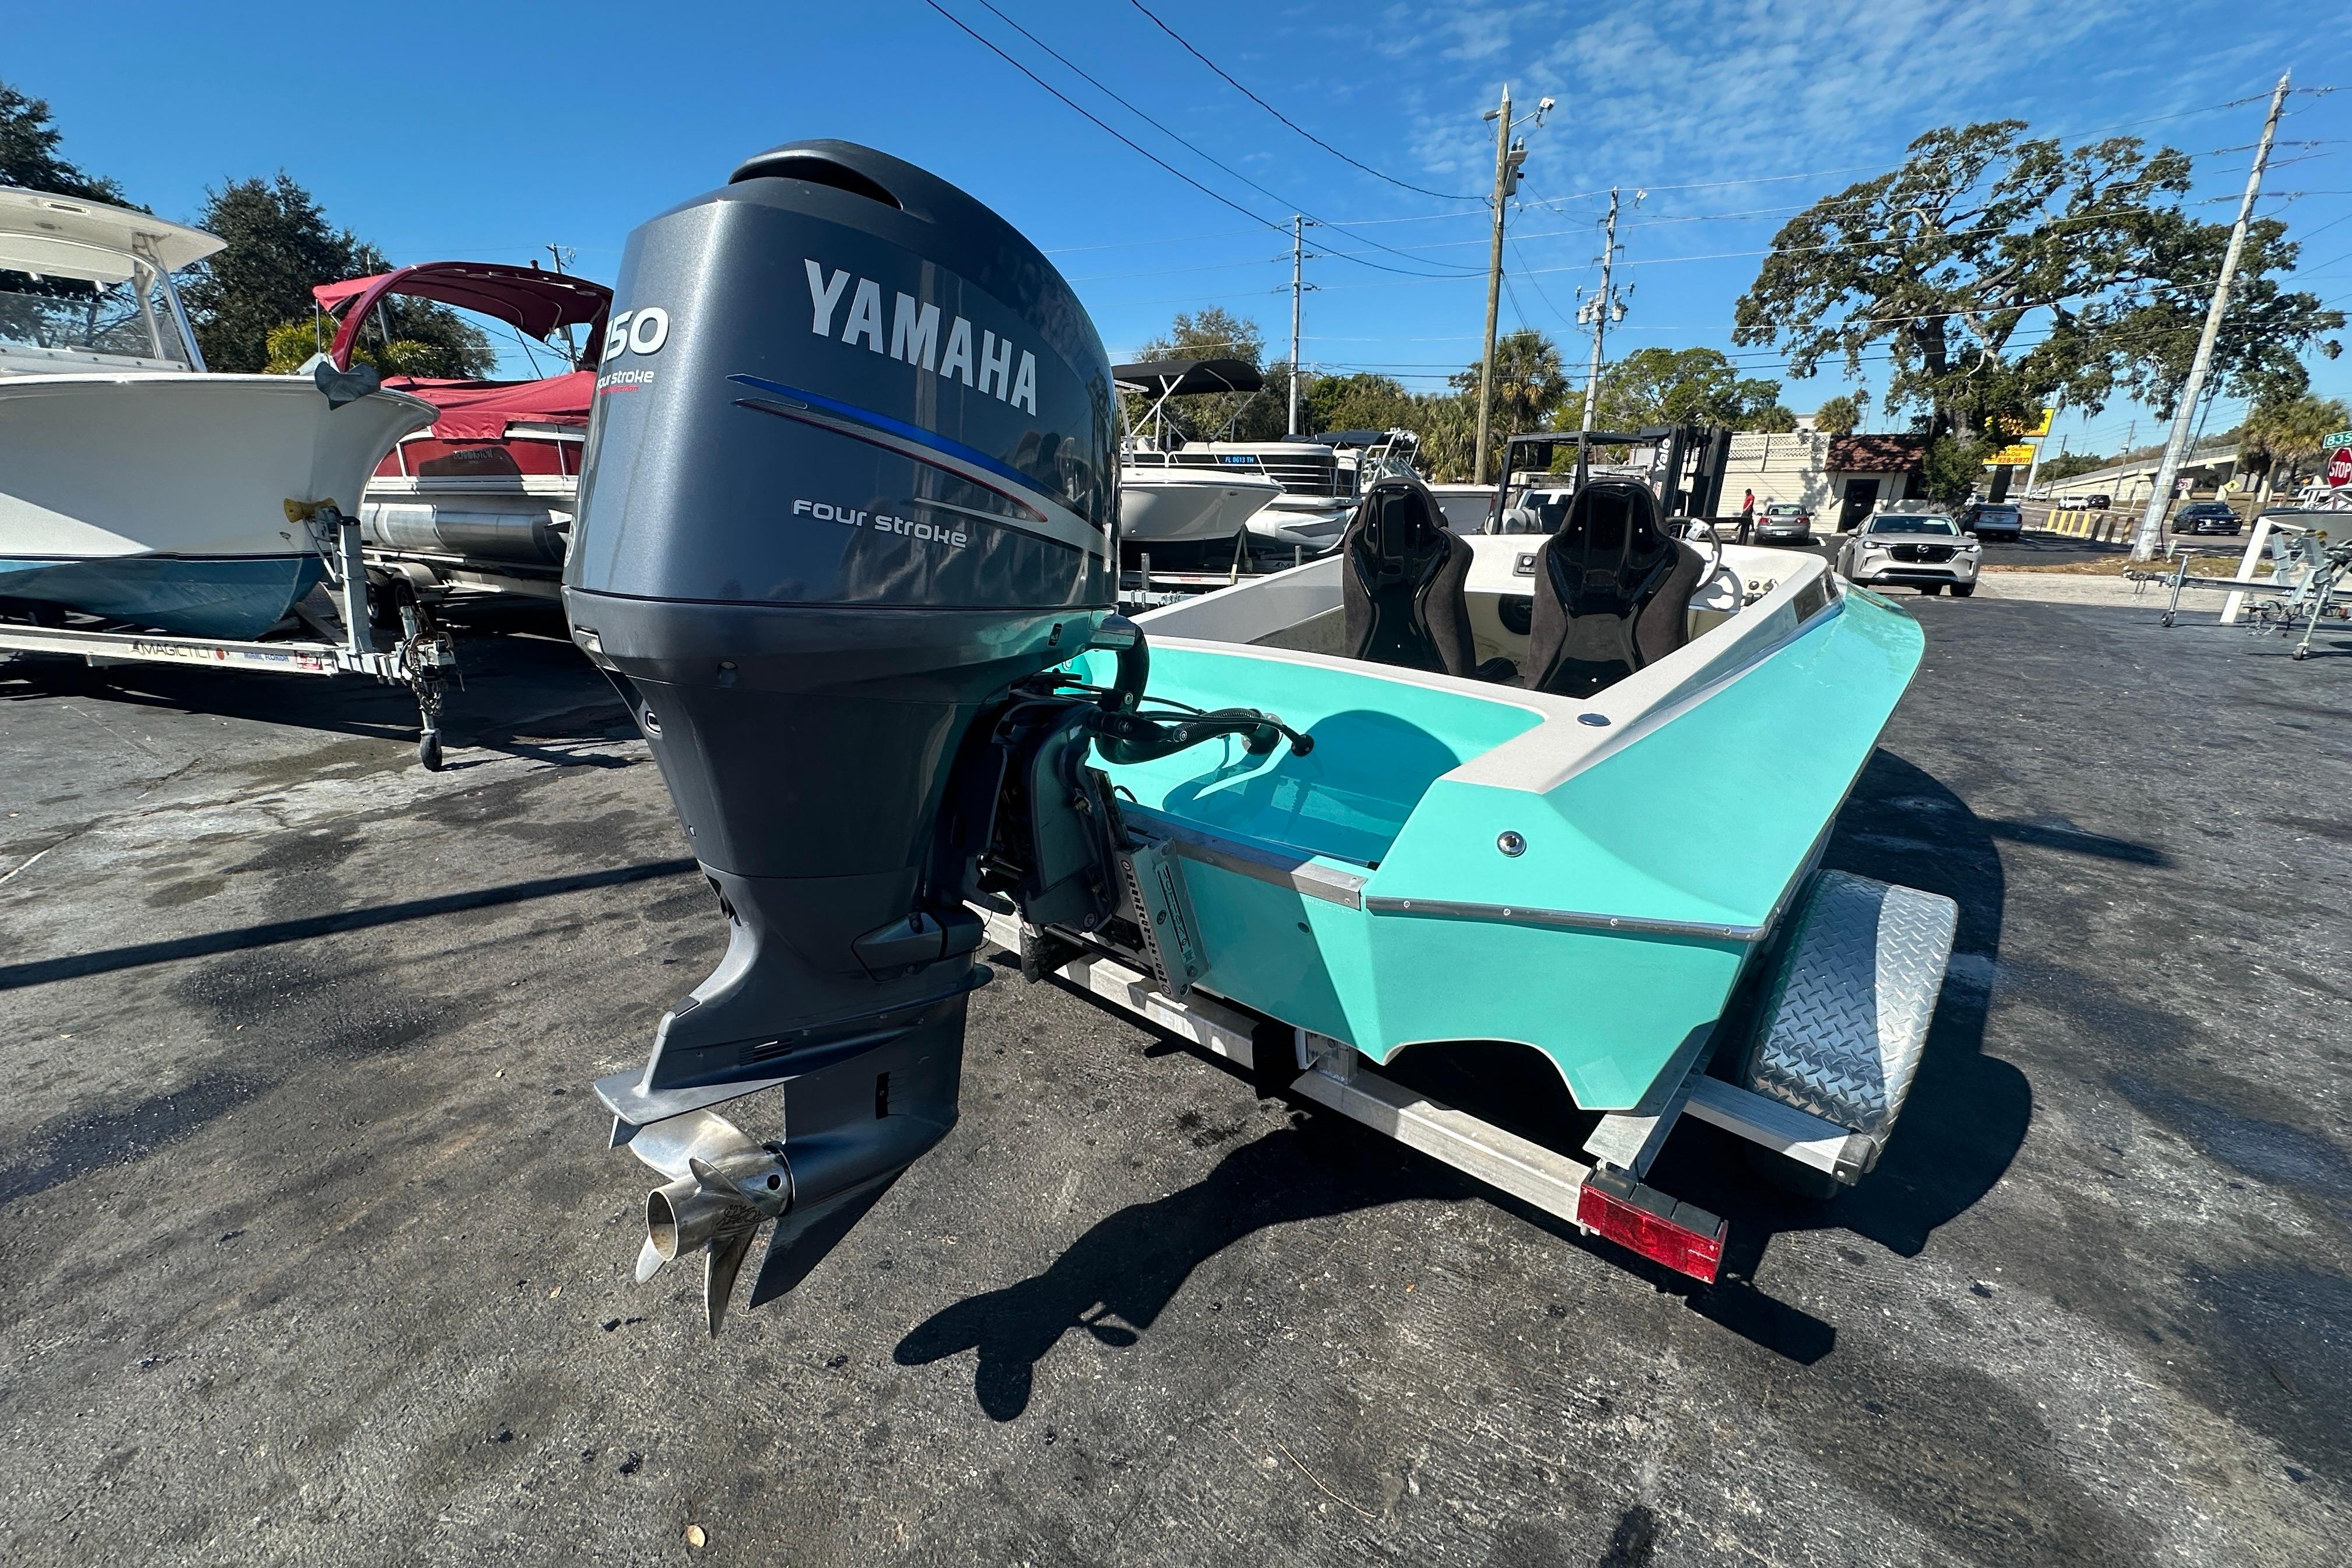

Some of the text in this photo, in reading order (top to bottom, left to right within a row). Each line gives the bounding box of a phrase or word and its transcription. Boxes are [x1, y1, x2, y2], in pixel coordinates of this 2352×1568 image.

[804, 258, 1036, 417] YAMAHA
[1655, 438, 1671, 472] Yale
[2329, 461, 2351, 478] STOP
